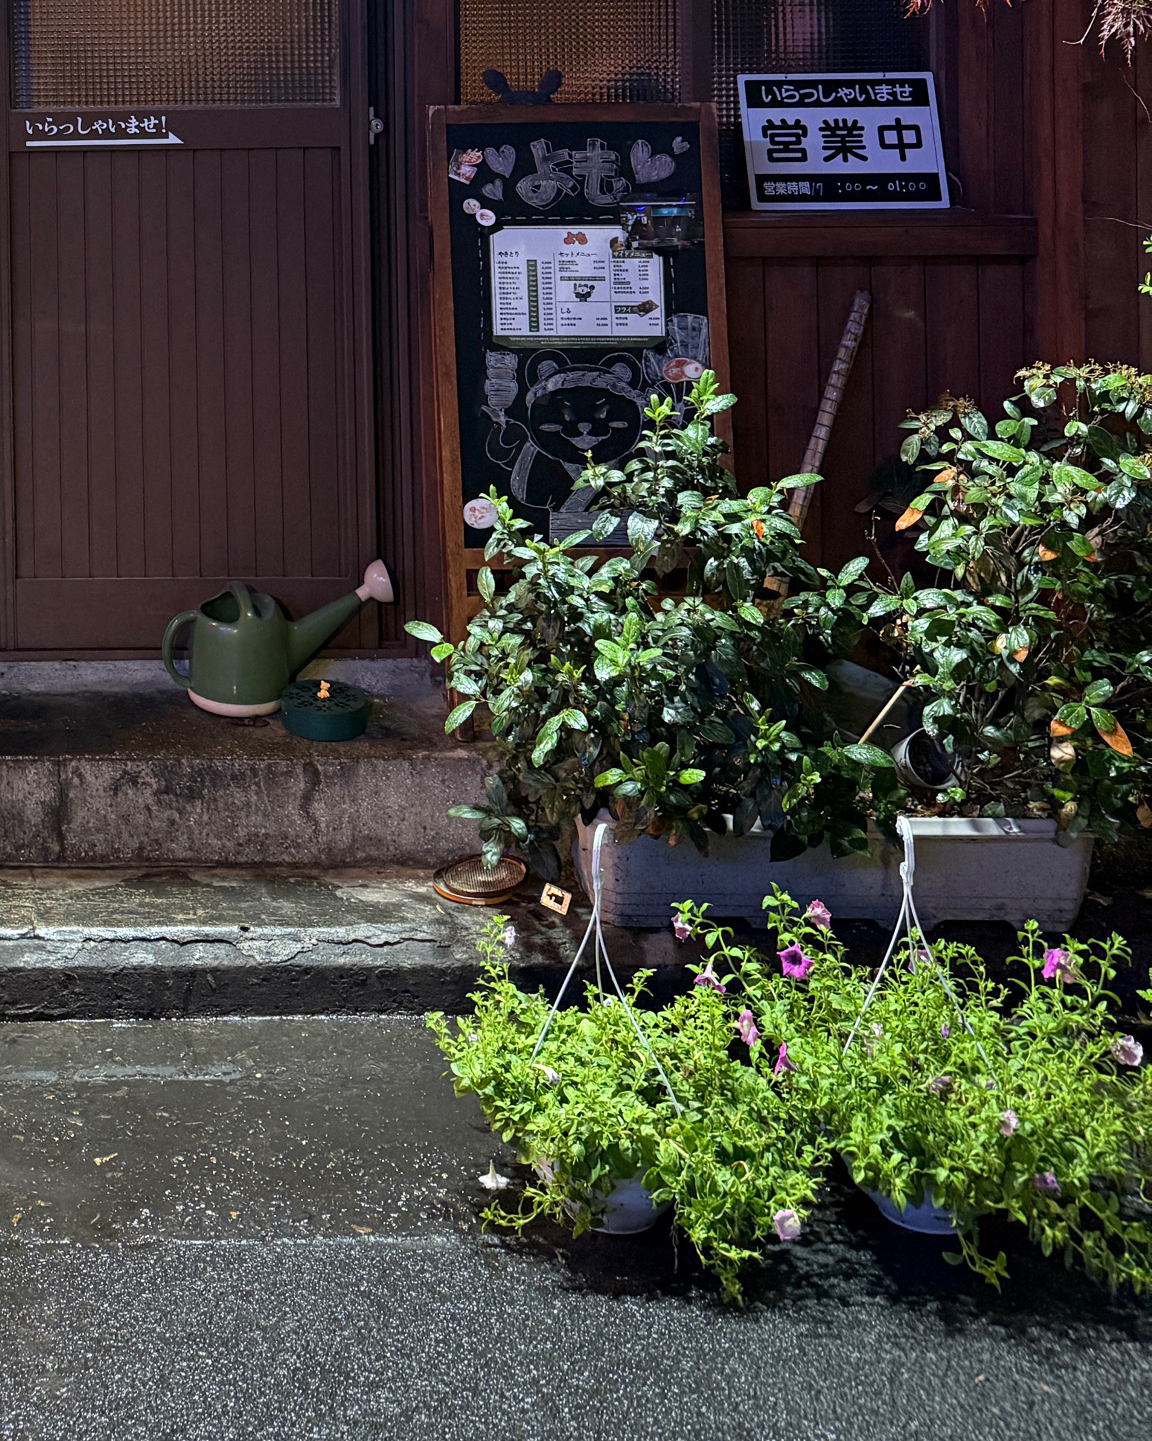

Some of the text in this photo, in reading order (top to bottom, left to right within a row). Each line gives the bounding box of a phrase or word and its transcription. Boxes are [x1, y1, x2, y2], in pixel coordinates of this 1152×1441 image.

[760, 84, 914, 104] いらっしゃいませ
[24, 115, 167, 136] いらっしゃいませ!
[761, 117, 924, 163] 営業中
[515, 138, 632, 210] よも
[763, 181, 811, 196] 営業時間
